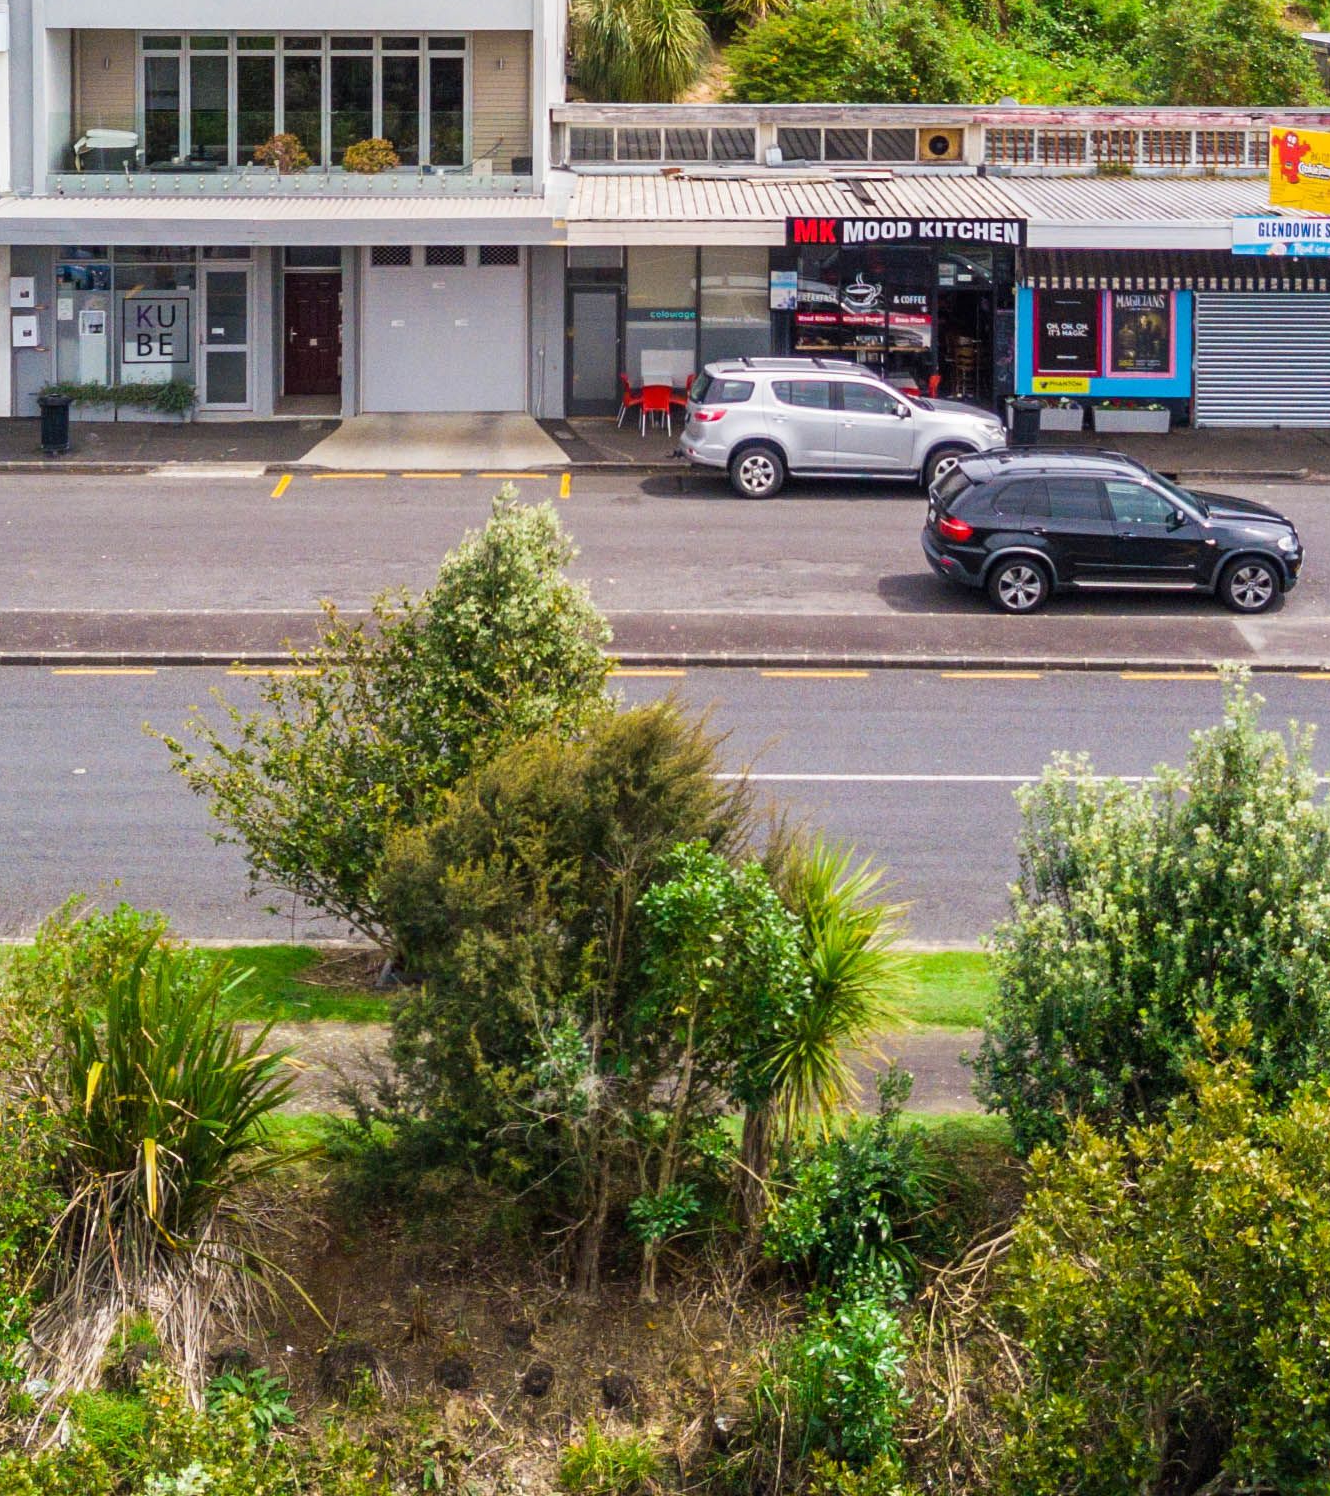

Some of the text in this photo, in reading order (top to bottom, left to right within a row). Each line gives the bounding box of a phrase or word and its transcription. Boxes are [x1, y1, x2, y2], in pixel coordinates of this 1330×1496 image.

[793, 219, 1019, 245] MK MOOD KITCHEN
[1258, 222, 1322, 238] GLENDOWIE
[901, 295, 926, 304] COFFEE
[1116, 294, 1165, 308] MAGICIANS
